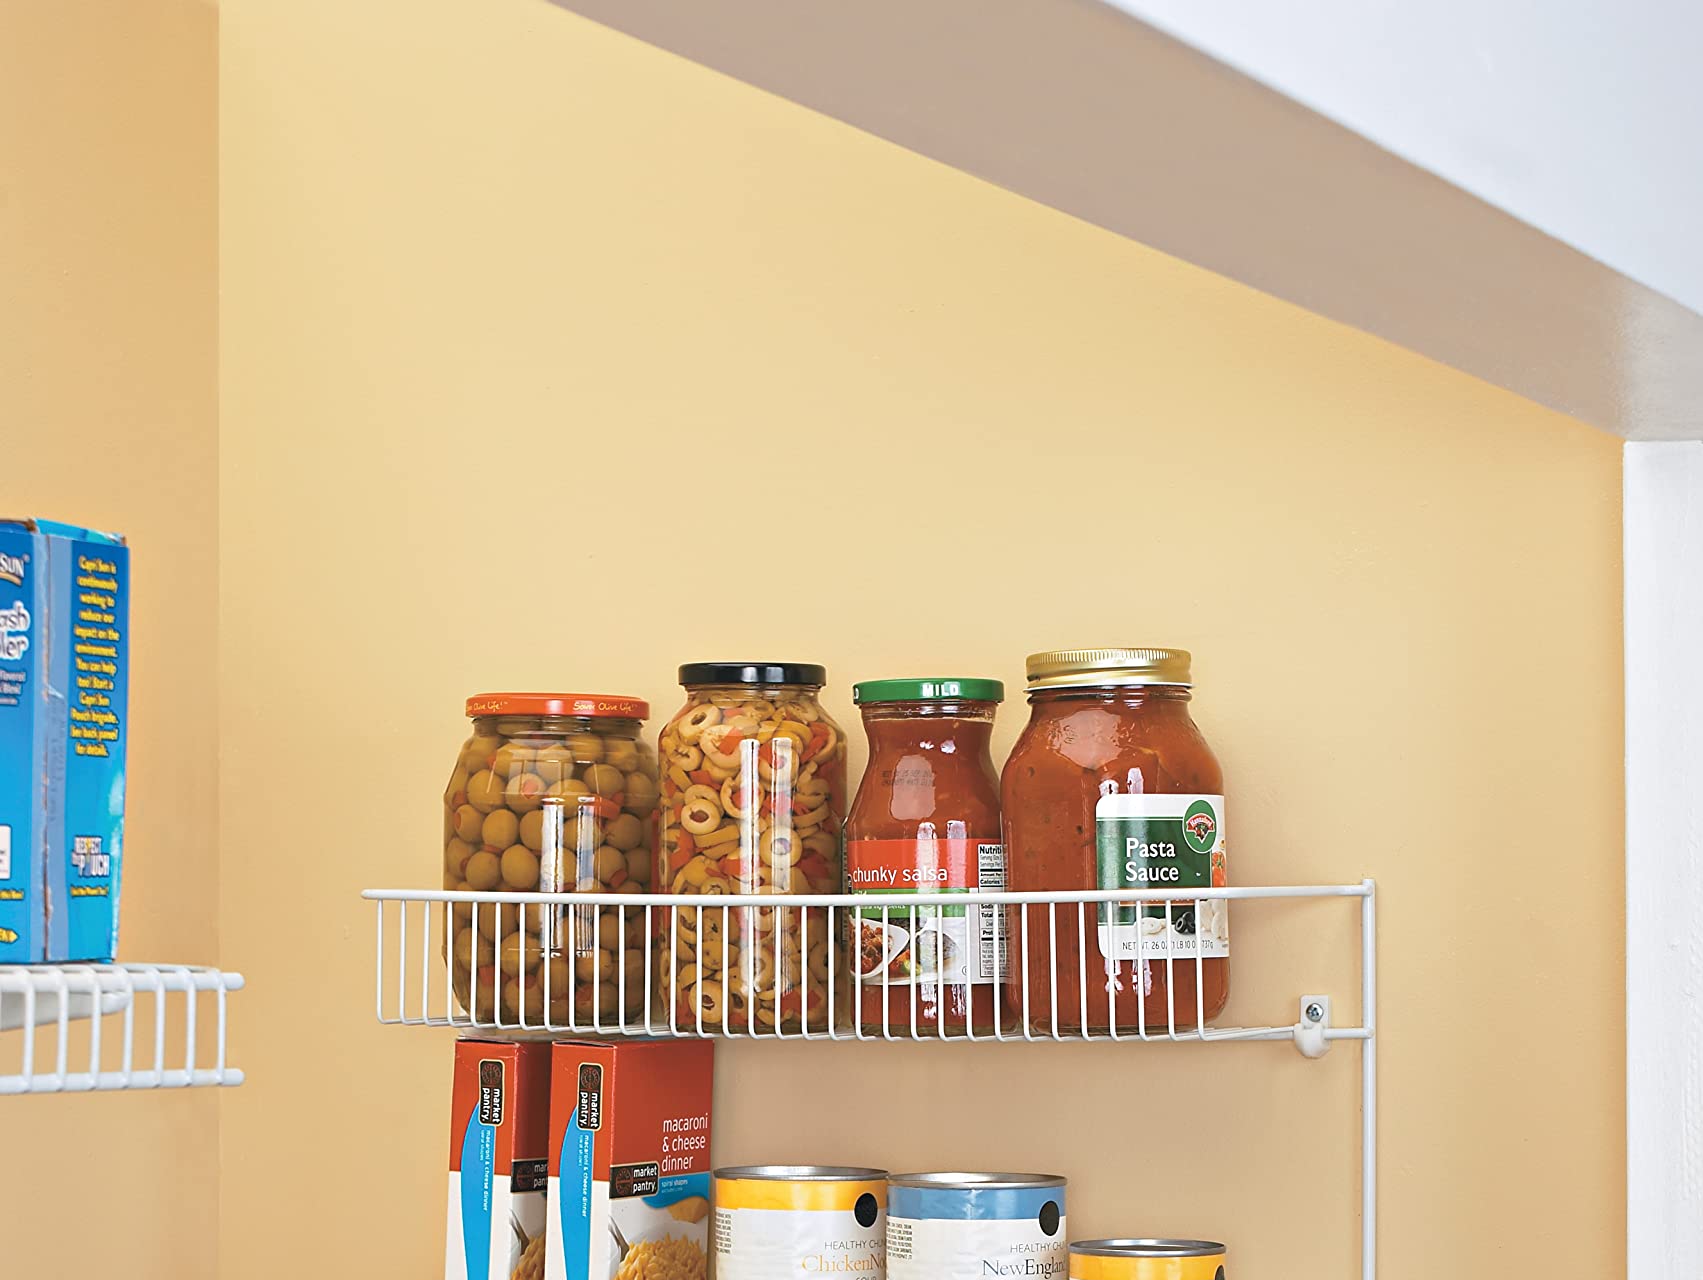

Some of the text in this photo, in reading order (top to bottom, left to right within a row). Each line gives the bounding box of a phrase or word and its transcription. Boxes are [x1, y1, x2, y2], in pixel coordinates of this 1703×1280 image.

[1126, 837, 1176, 858] Pasta
[853, 865, 948, 885] chunky salsa
[1125, 862, 1179, 882] Sauce
[1122, 941, 1136, 950] NET
[1151, 941, 1159, 950] 26
[1161, 941, 1168, 950] O
[481, 1087, 491, 1122] pantry.
[492, 1088, 501, 1123] market
[579, 1091, 588, 1127] pantry.
[590, 1092, 598, 1128] market
[663, 1113, 709, 1132] macaroni
[662, 1134, 706, 1152] & cheese
[633, 1165, 658, 1178] market
[662, 1154, 693, 1172] dinner
[632, 1180, 657, 1195] pantry.
[824, 1240, 867, 1250] HEALTHY
[1010, 1242, 1050, 1253] HEALTHY
